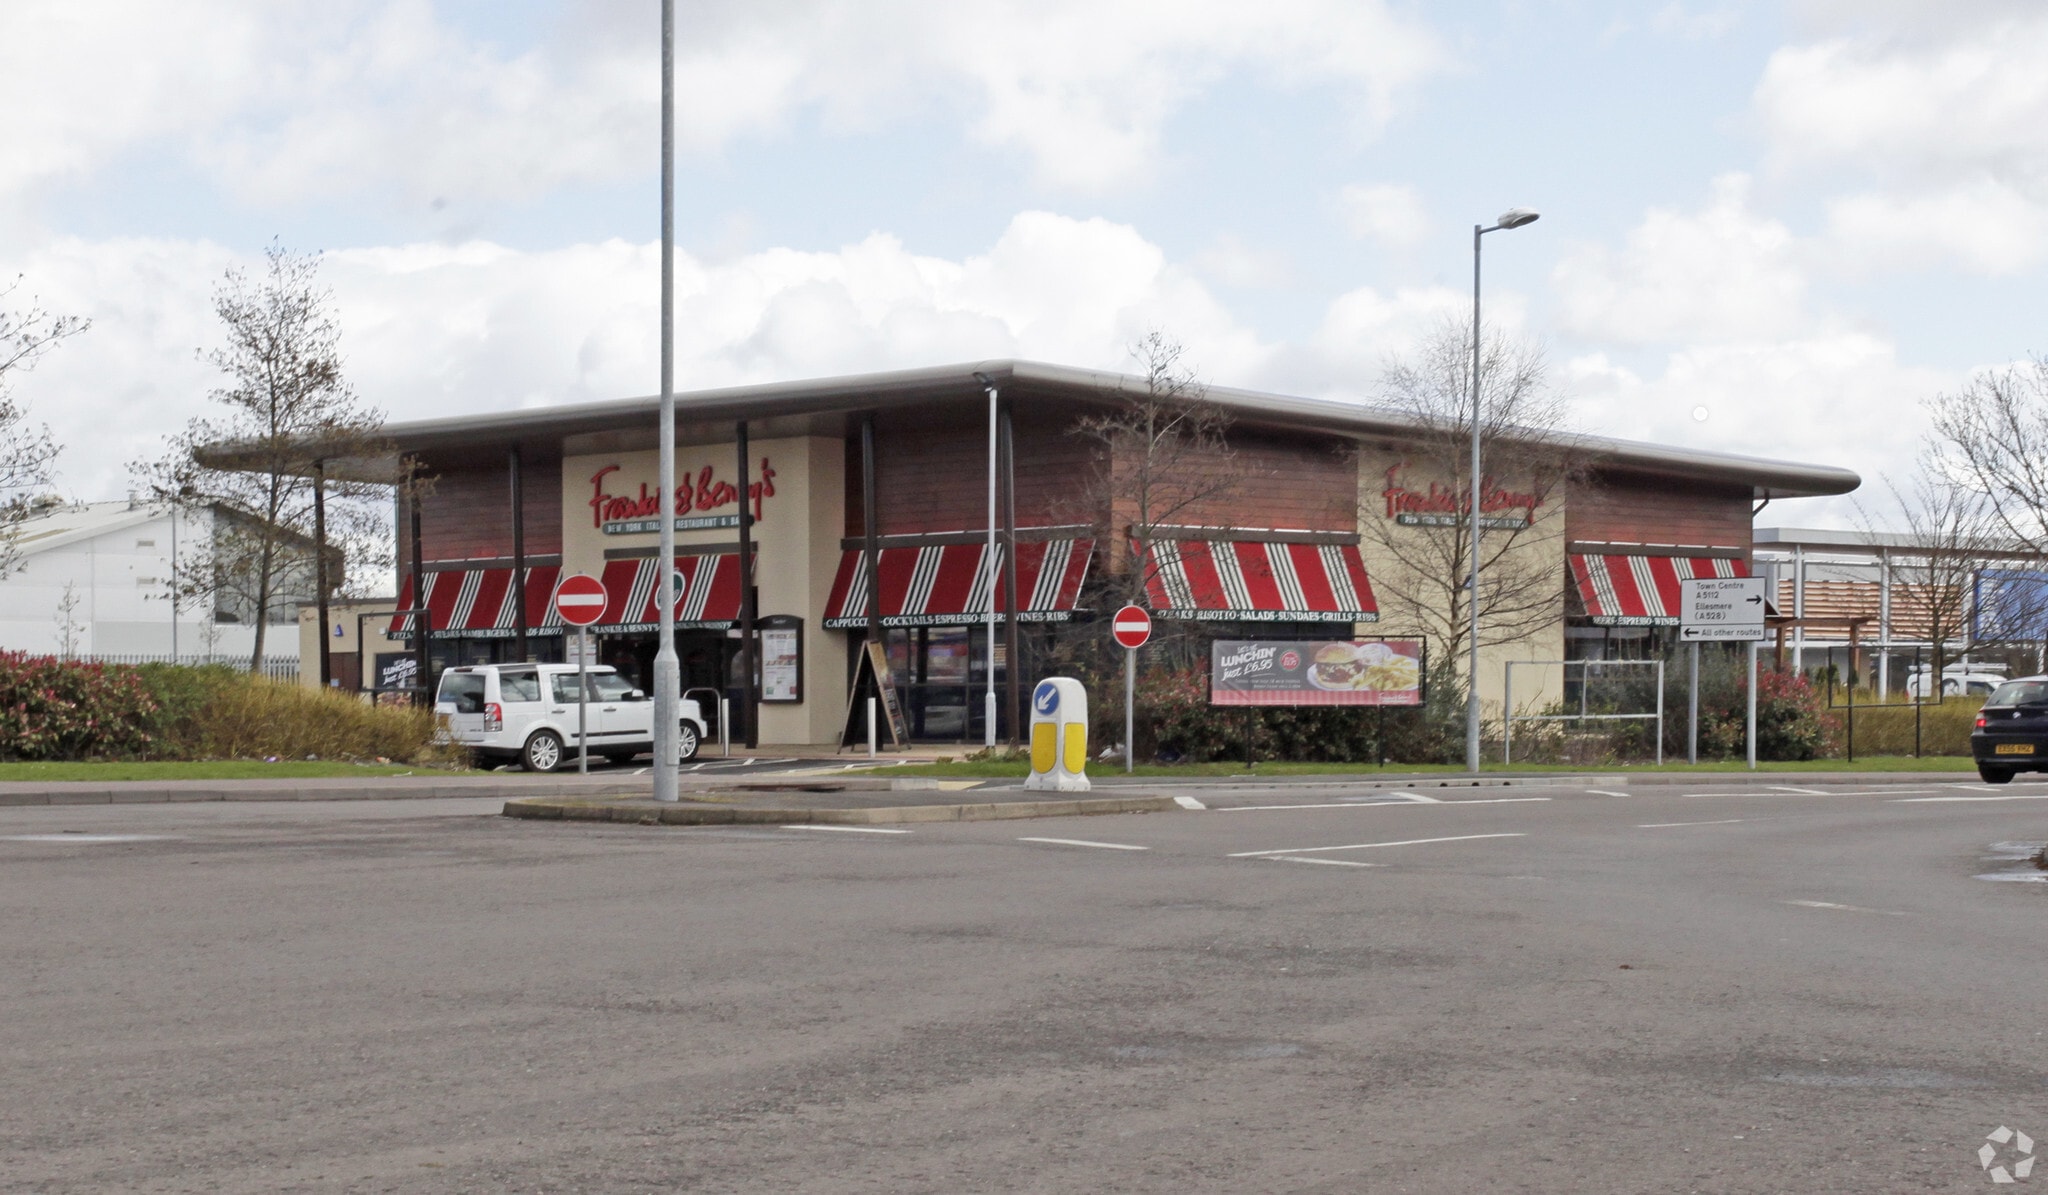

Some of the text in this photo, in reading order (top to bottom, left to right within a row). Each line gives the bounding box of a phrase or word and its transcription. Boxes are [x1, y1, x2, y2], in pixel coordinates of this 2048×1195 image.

[589, 465, 661, 528] Franki
[695, 457, 776, 522] Beny's
[607, 524, 621, 533] NEW
[626, 522, 642, 532] YORK
[675, 517, 717, 529] RESTAURANT
[1696, 582, 1744, 590] Town Centre
[1695, 602, 1732, 610] Ellesmere
[825, 618, 869, 628] CAPPUCCI
[882, 615, 933, 626] COCKTAILS
[935, 613, 977, 624] ESPRESSO
[1046, 611, 1069, 621] RIBS
[1196, 610, 1236, 620] RISOTTO
[1239, 610, 1275, 621] SALADS
[1278, 611, 1319, 621] SUNDAES
[1321, 611, 1353, 621] GRILLS
[1653, 617, 1679, 625] WINES
[1714, 628, 1734, 636] other
[1736, 628, 1761, 636] routes
[1221, 647, 1277, 667] LUNCHIN'
[1221, 667, 1242, 681] just
[1243, 659, 1273, 675] £6.95
